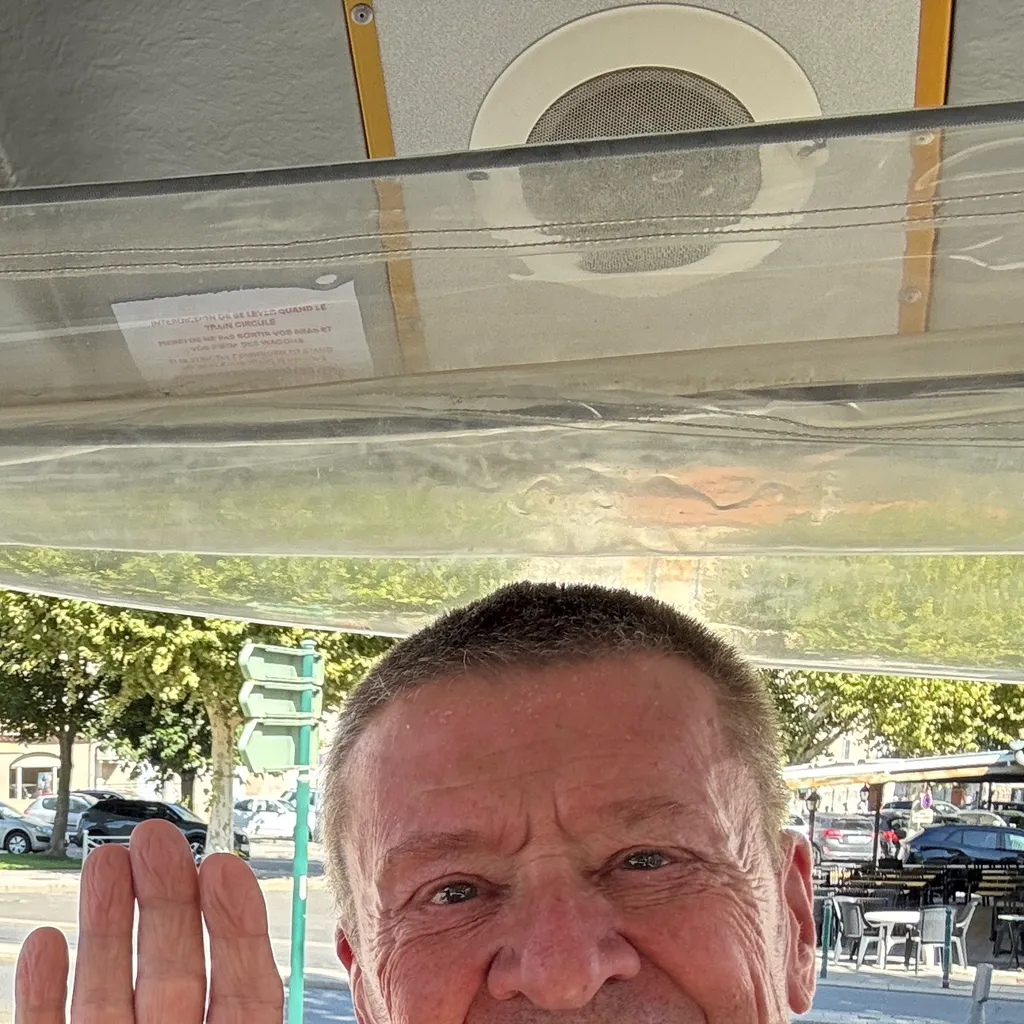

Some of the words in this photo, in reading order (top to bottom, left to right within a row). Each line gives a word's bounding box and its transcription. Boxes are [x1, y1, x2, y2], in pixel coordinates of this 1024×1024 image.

[278, 304, 314, 316] QUAND
[314, 303, 327, 312] LE
[204, 322, 233, 331] TRAIN
[234, 318, 276, 329] CIRCULE
[236, 330, 272, 340] SORTIR
[272, 328, 293, 337] VOS
